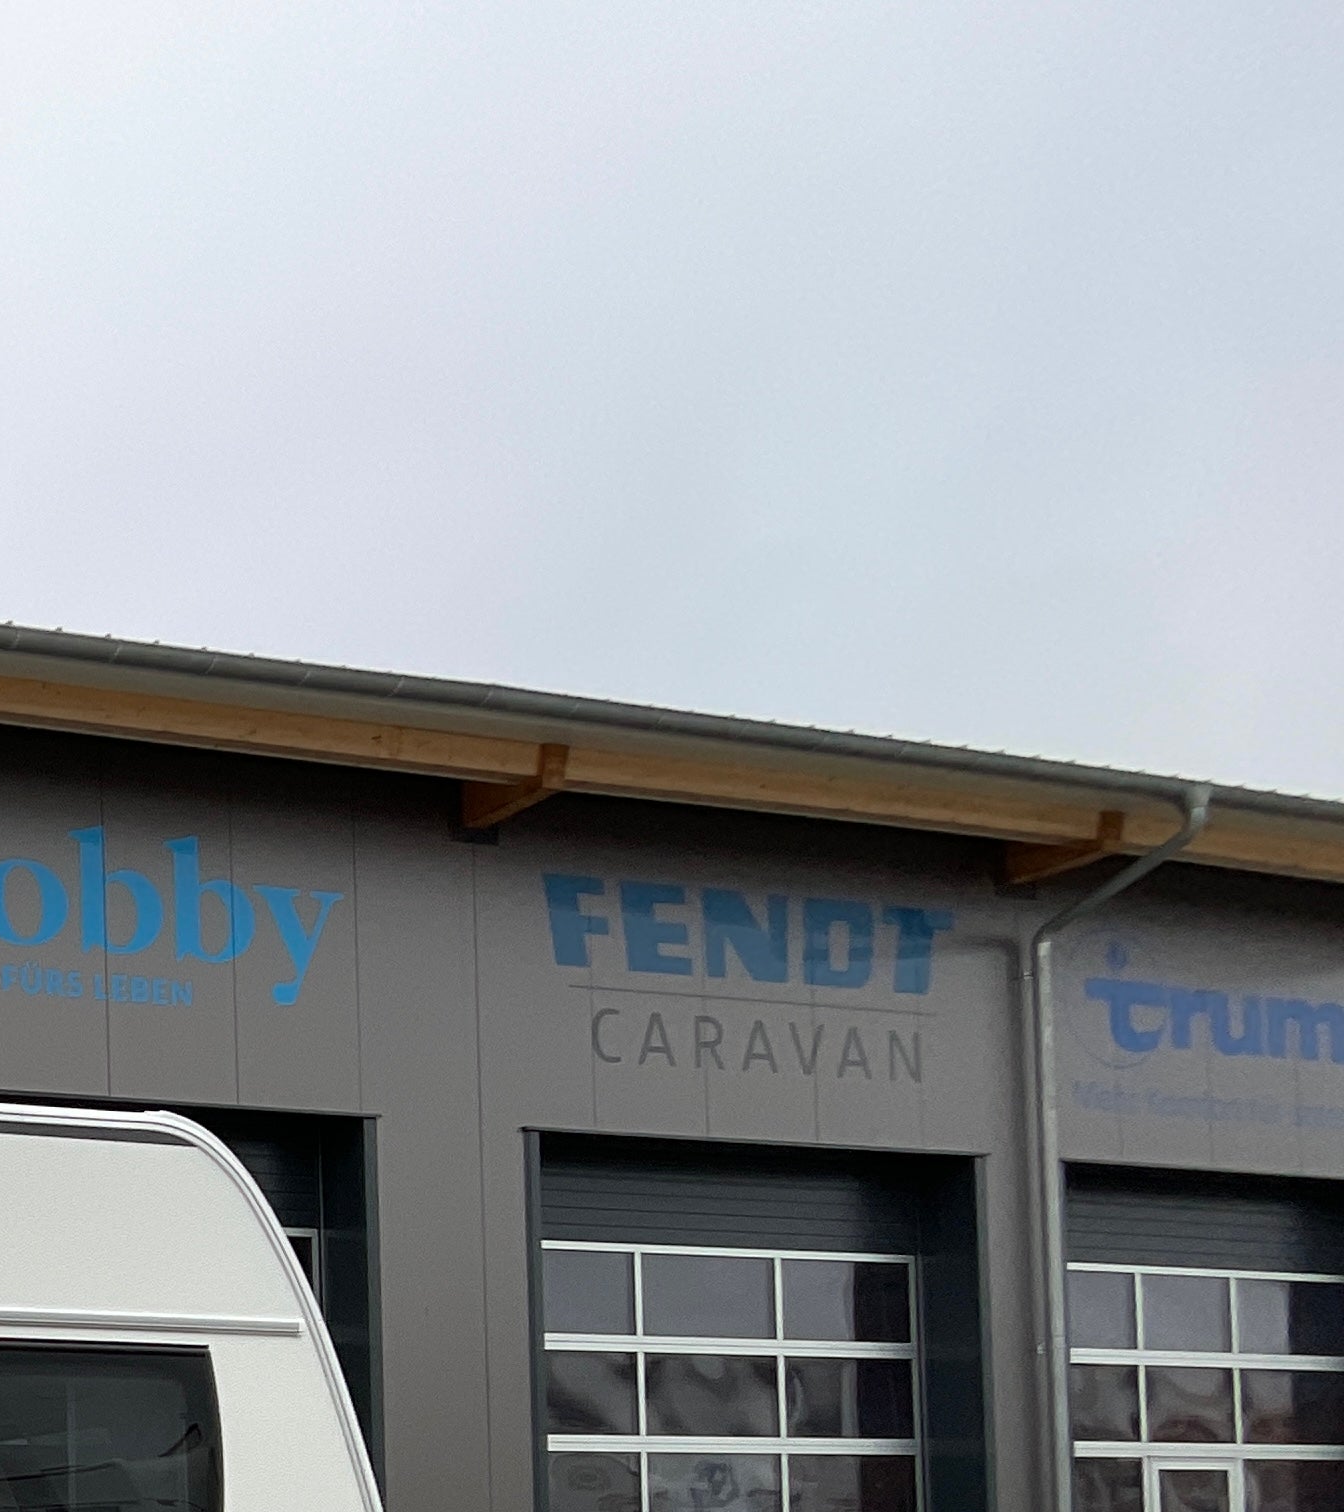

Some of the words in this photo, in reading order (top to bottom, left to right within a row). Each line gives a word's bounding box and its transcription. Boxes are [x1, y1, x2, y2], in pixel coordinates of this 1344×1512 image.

[542, 872, 958, 996] FENDT
[0, 960, 85, 998] FÜRS
[93, 973, 194, 1007] LEBEN
[590, 1007, 923, 1084] CARAVAN
